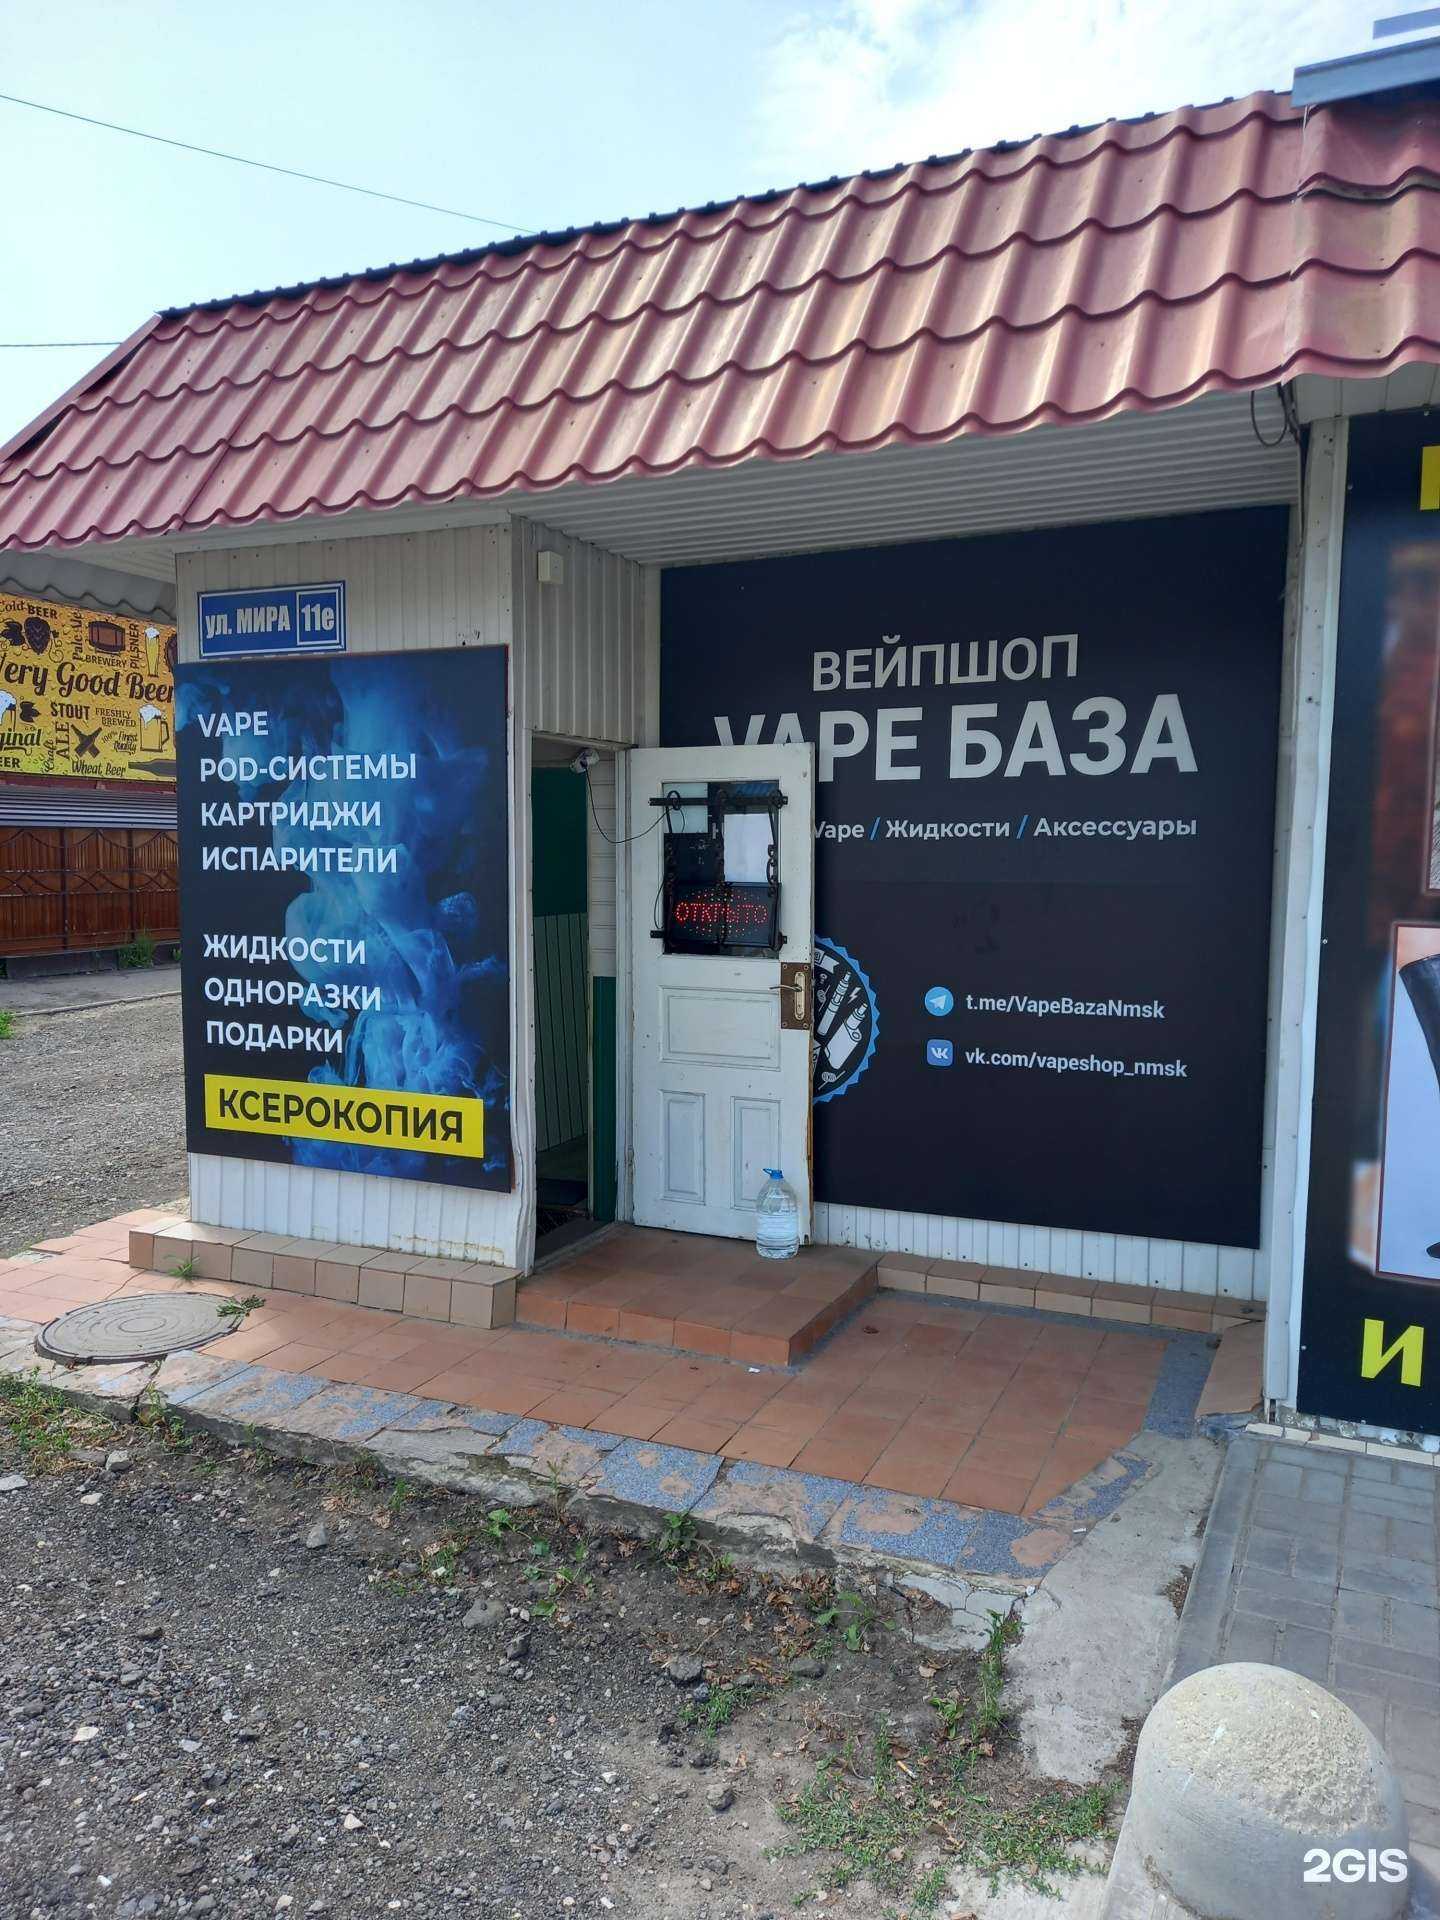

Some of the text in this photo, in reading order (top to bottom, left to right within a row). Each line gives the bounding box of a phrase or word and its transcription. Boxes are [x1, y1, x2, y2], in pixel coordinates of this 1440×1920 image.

[27, 602, 58, 620] BEER
[205, 605, 291, 639] ул. МИРА
[300, 603, 335, 632] 11е
[71, 635, 84, 661] Pale
[129, 622, 140, 670] PILSNER
[85, 654, 127, 669] BREWERY
[813, 634, 1079, 692] ВЕЙПШОП
[57, 661, 120, 698] Good
[50, 701, 90, 721] STOUT
[95, 707, 132, 720] FRESHLY
[101, 716, 137, 728] BREWED
[198, 711, 269, 737] VAPE
[55, 720, 70, 761] ALE
[949, 693, 1199, 780] БАЗА
[71, 757, 127, 777] Wheat Beer
[200, 753, 417, 782] POD-СИСТЕМЫ
[201, 801, 381, 831] КАРТРИДЖИ
[885, 819, 1011, 840] Жидкости
[1033, 816, 1198, 840] Аксессуары
[202, 847, 398, 873] ИСПАРИТЕЛИ
[203, 934, 366, 965] ЖИДКОСТИ
[204, 977, 381, 1012] ОДНОРАЗКИ
[965, 994, 1166, 1019] t.me/VapeBazaNmsk
[206, 1020, 343, 1054] ПОДАРКИ
[965, 1047, 1188, 1078] vk.com/vapeshop_nmsk
[218, 1087, 463, 1144] КСЕРОКОПИЯ
[1361, 1318, 1425, 1387] И
